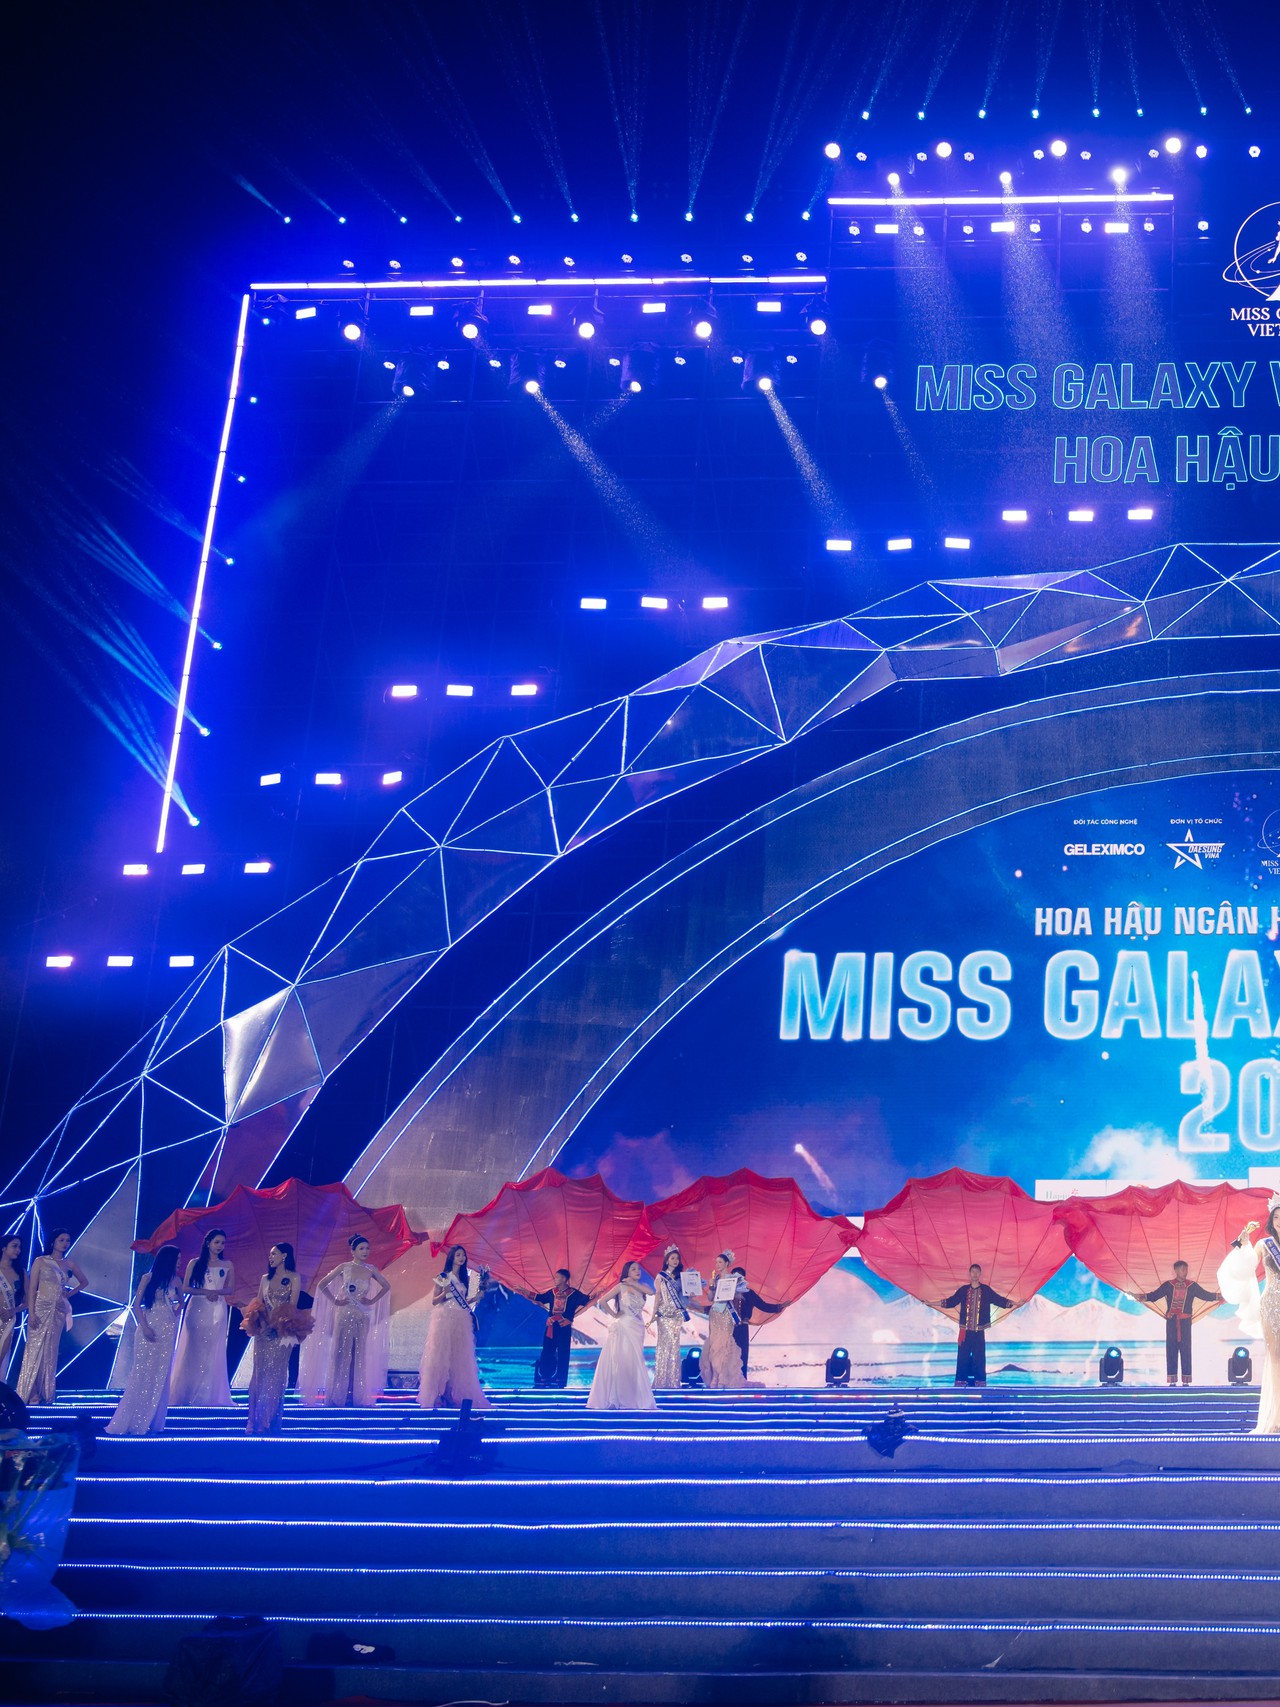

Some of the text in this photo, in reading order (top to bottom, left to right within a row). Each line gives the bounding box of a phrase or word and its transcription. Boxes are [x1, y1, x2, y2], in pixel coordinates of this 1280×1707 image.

[1230, 307, 1272, 321] MISS
[915, 363, 1037, 411] MISS
[1052, 361, 1256, 410] GALAXY
[1053, 436, 1160, 484] HOA
[1175, 426, 1280, 491] HẬU
[1063, 843, 1146, 856] GELEXIMCO
[1188, 845, 1223, 853] DAESUNG
[1261, 859, 1279, 867] MISS
[1034, 907, 1093, 936] HOA
[1103, 900, 1163, 940] HẬU
[1174, 900, 1259, 936] NGÂN
[779, 949, 1013, 1041] MISS
